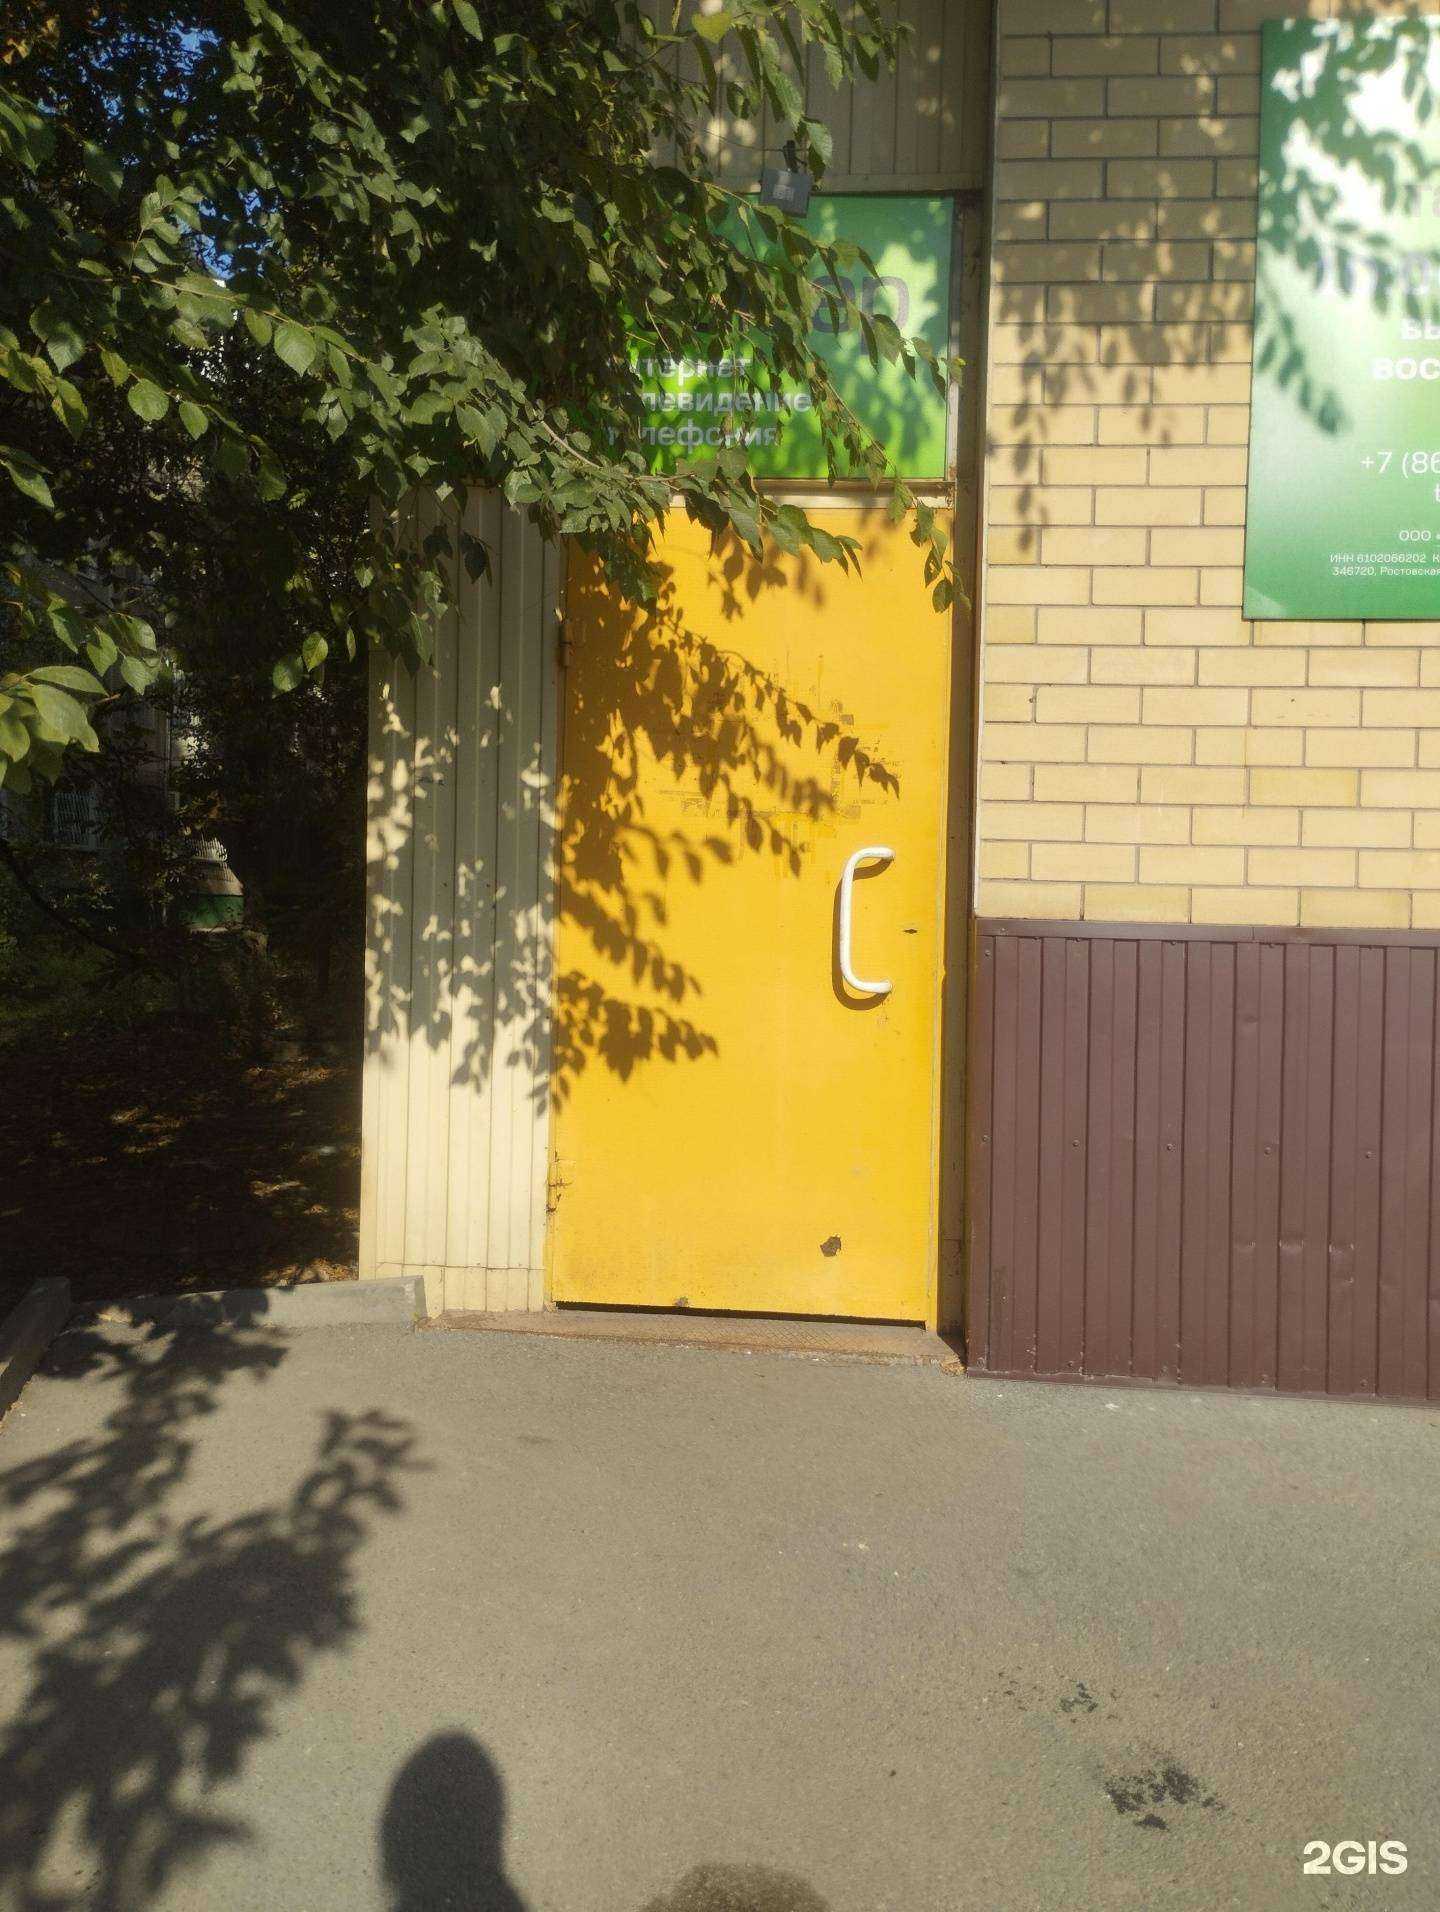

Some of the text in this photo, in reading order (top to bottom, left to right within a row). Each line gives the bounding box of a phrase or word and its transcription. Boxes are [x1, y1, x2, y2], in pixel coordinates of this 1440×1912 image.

[640, 358, 752, 387] тернет
[640, 391, 812, 416] левидение
[1360, 451, 1392, 473] +7
[1399, 530, 1431, 541] ООО
[1330, 553, 1354, 563] ИНН
